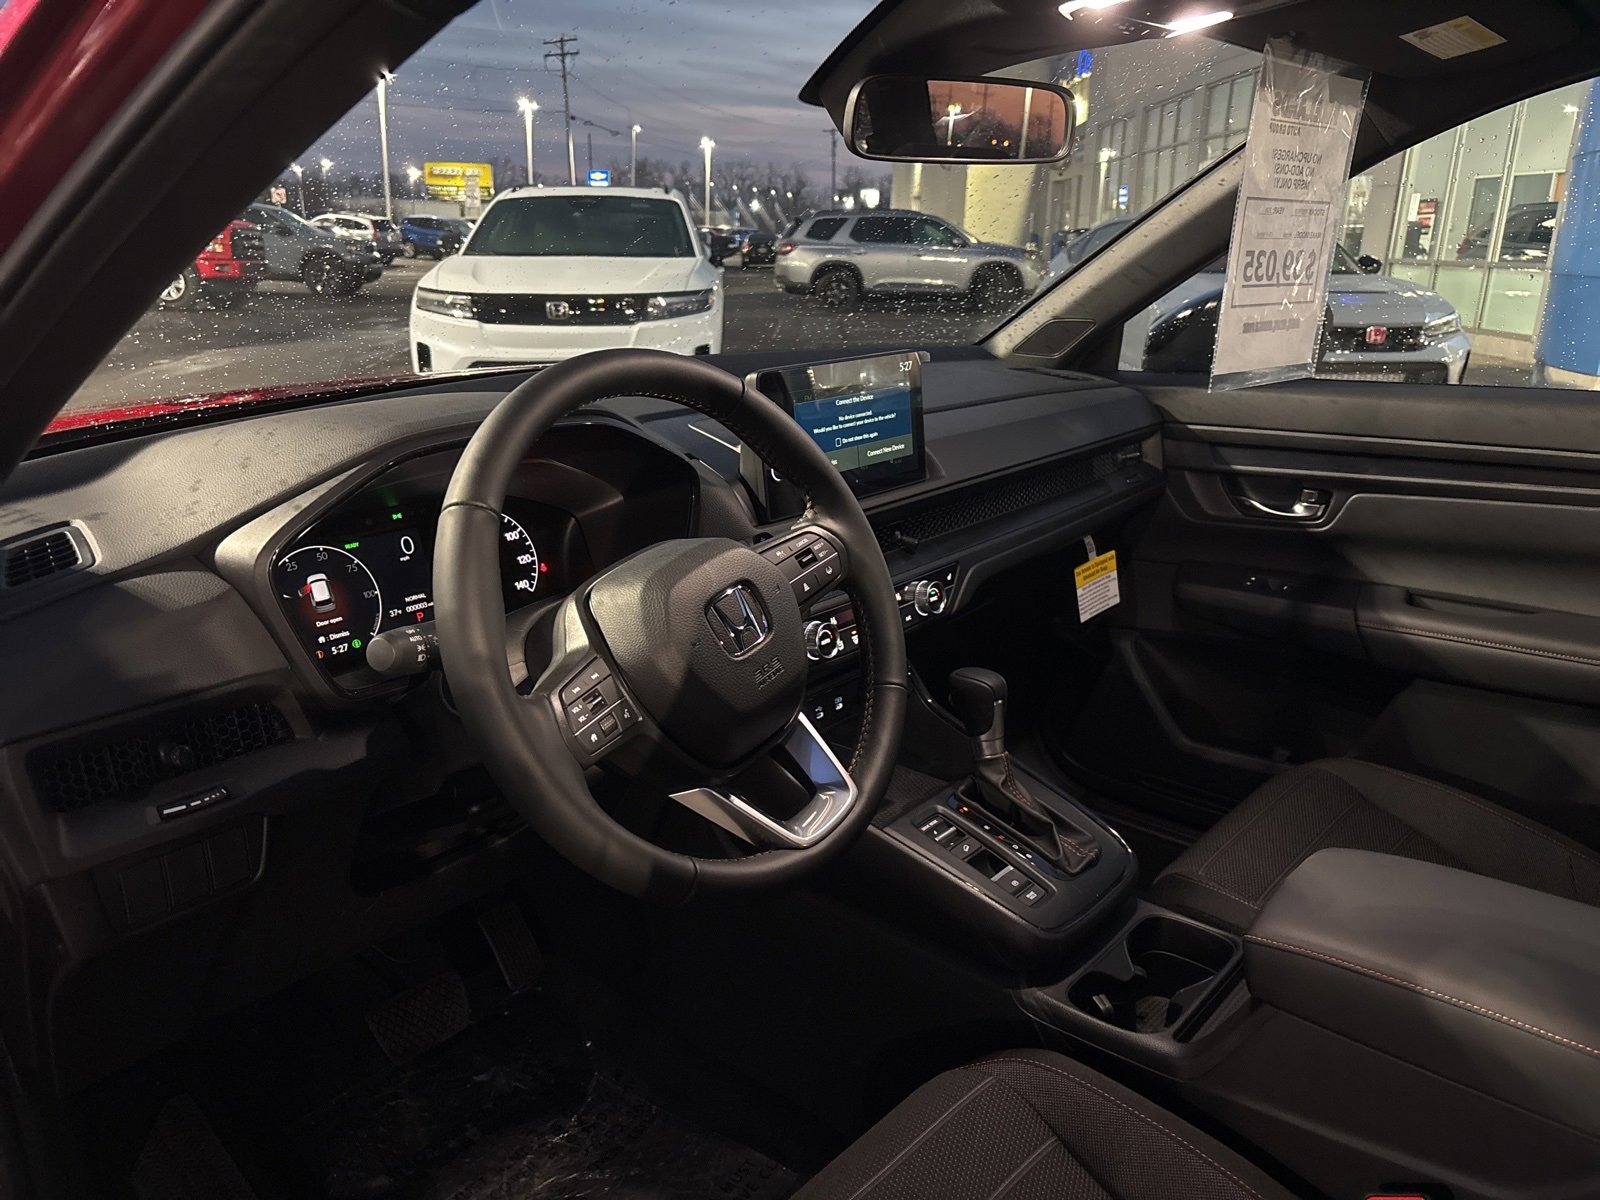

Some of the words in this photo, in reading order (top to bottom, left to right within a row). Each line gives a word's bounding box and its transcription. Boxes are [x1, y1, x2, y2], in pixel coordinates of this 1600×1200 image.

[899, 360, 913, 372] 5:27
[835, 398, 853, 406] Connect
[867, 448, 883, 456] Connect
[891, 443, 905, 451] Device
[504, 530, 520, 541] 100
[344, 541, 360, 550] READY
[400, 535, 415, 555] 0
[316, 551, 329, 562] 50
[516, 553, 532, 565] 120
[285, 561, 298, 572] 25
[345, 563, 358, 573] 75
[514, 579, 530, 591] 140
[363, 589, 376, 599] 100
[404, 592, 427, 603] NORMAL
[315, 619, 330, 628] Door
[330, 616, 344, 624] open
[416, 611, 424, 622] P
[329, 630, 351, 641] Dismiss
[331, 642, 349, 655] 5:27
